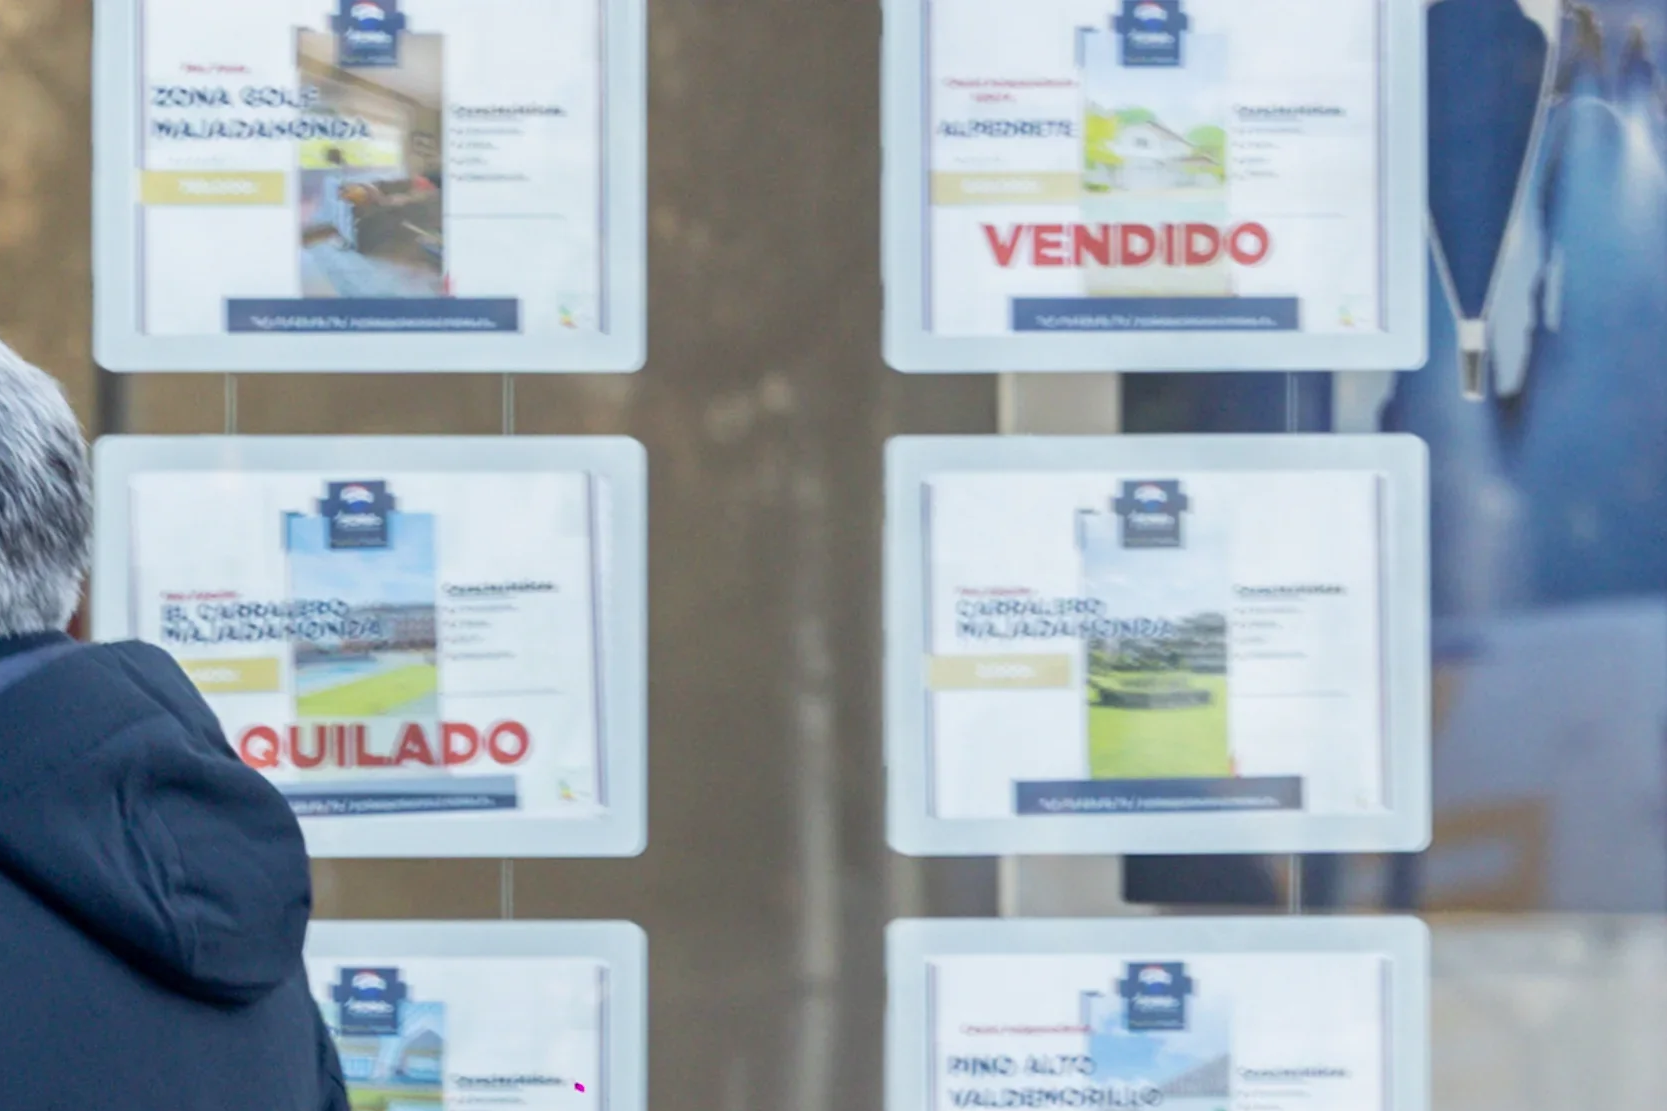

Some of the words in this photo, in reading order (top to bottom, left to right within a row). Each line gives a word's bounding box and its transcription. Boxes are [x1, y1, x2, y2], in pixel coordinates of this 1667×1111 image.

[151, 85, 231, 107] ZONA
[152, 118, 373, 141] MAJADAHONDA
[981, 221, 1272, 269] VENDIDO
[161, 619, 384, 643] MAJADAHONDA
[956, 617, 1175, 639] MAJADAHONDA
[238, 720, 531, 770] QUILADO
[948, 1054, 1017, 1077] PINO
[1023, 1054, 1096, 1077] ALTO
[949, 1086, 1164, 1110] VALDEMORILLO
